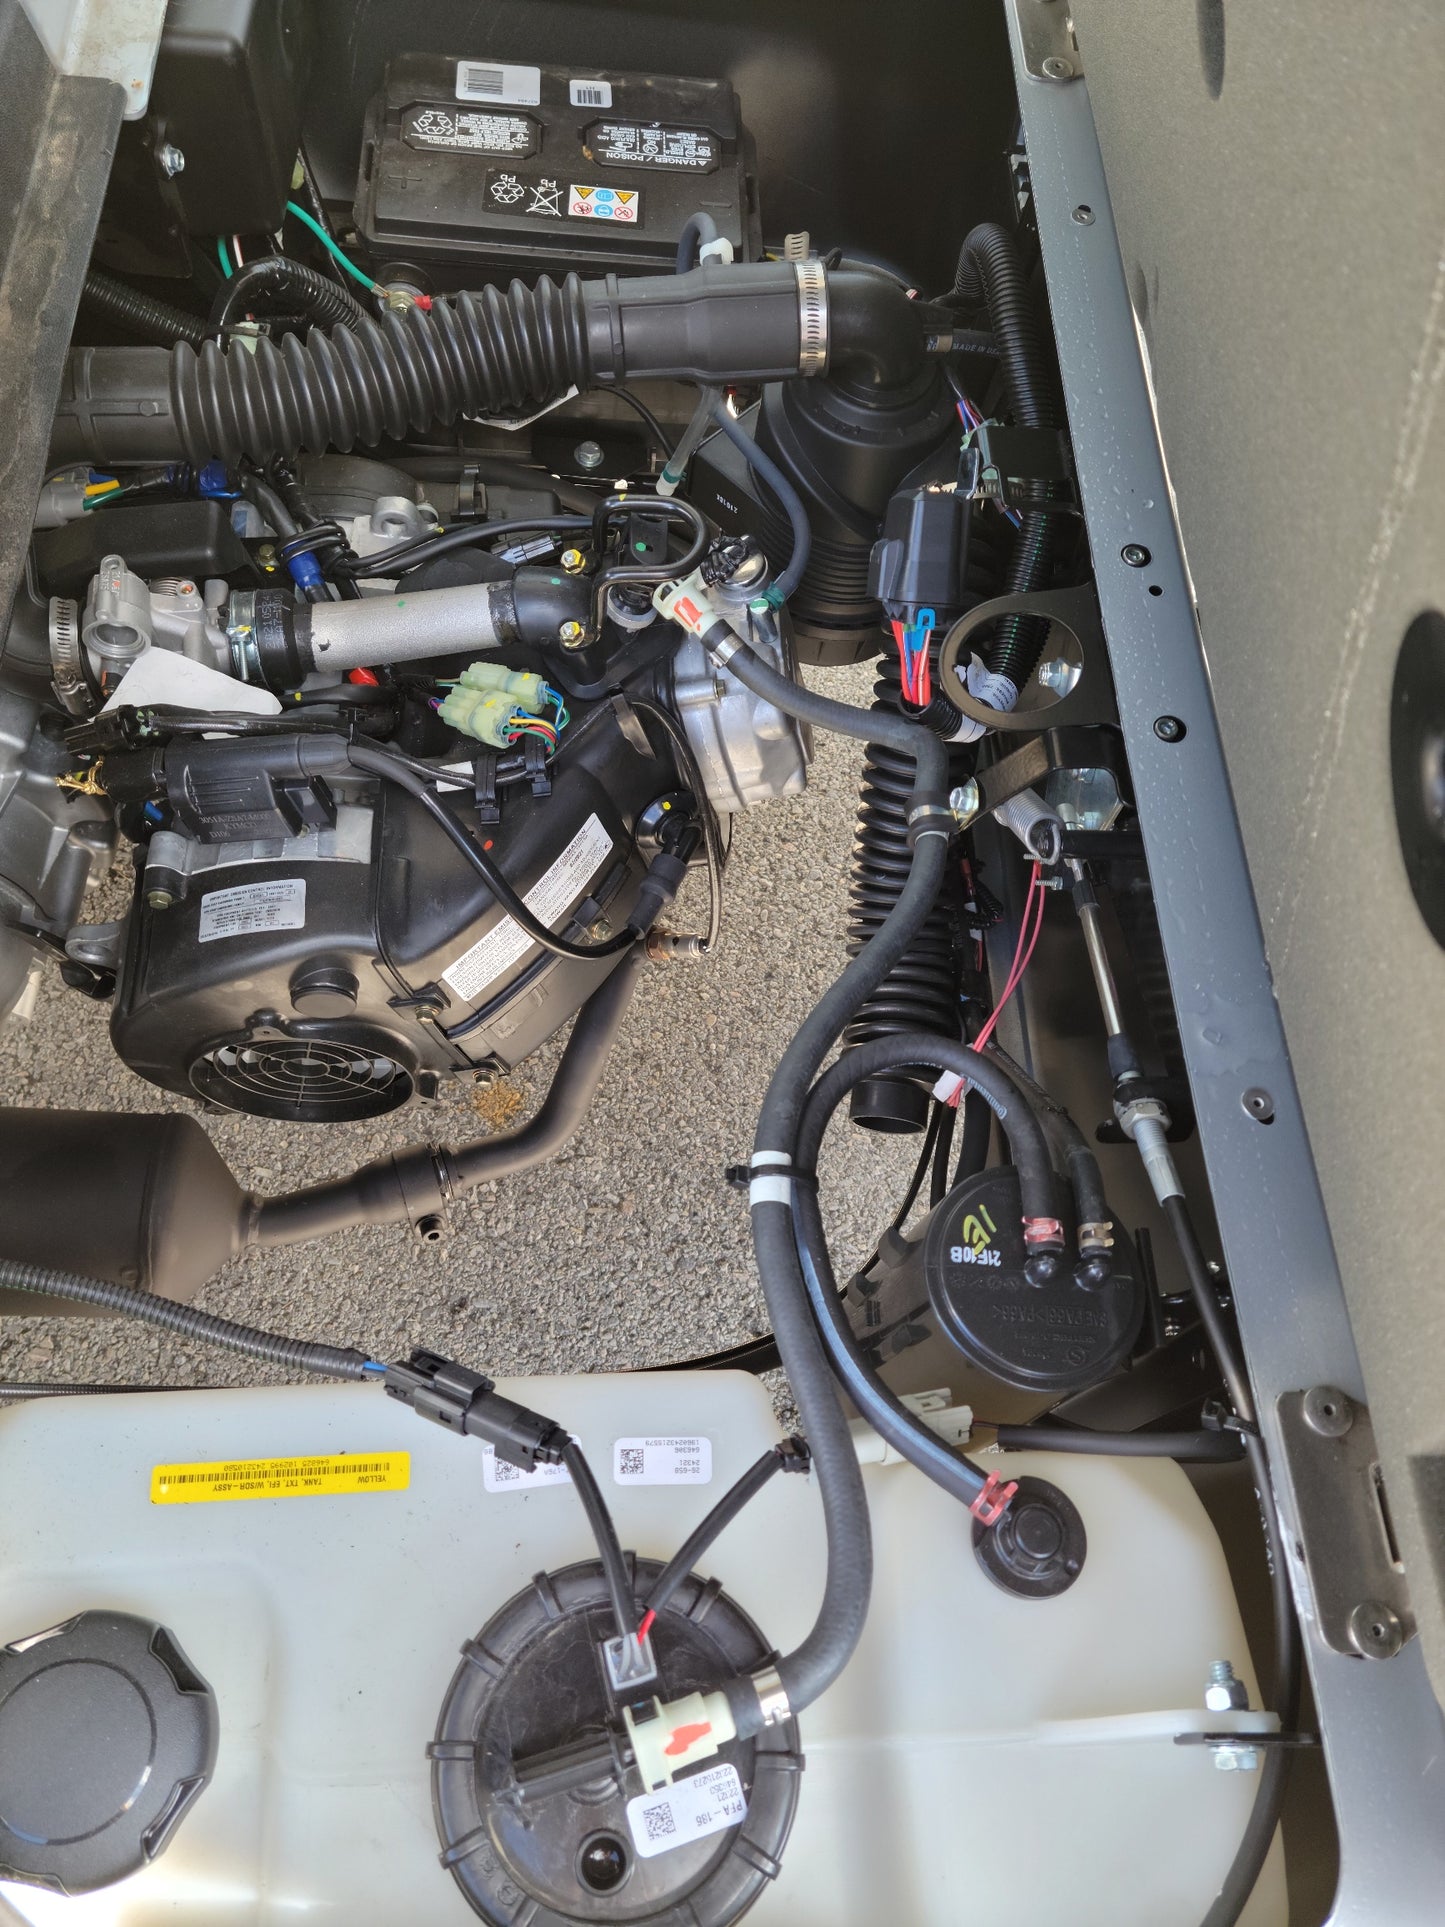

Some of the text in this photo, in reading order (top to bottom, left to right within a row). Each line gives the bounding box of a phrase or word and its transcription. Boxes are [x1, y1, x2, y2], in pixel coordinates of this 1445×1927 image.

[606, 151, 643, 160] POISON
[654, 156, 696, 165] DANGER
[500, 173, 516, 182] Pb
[540, 178, 556, 187] Pb
[456, 936, 493, 968] IMPORTANT
[550, 829, 586, 873] INFORMATION
[950, 1246, 1001, 1266] 21F10B
[358, 1475, 386, 1484] YELLOW
